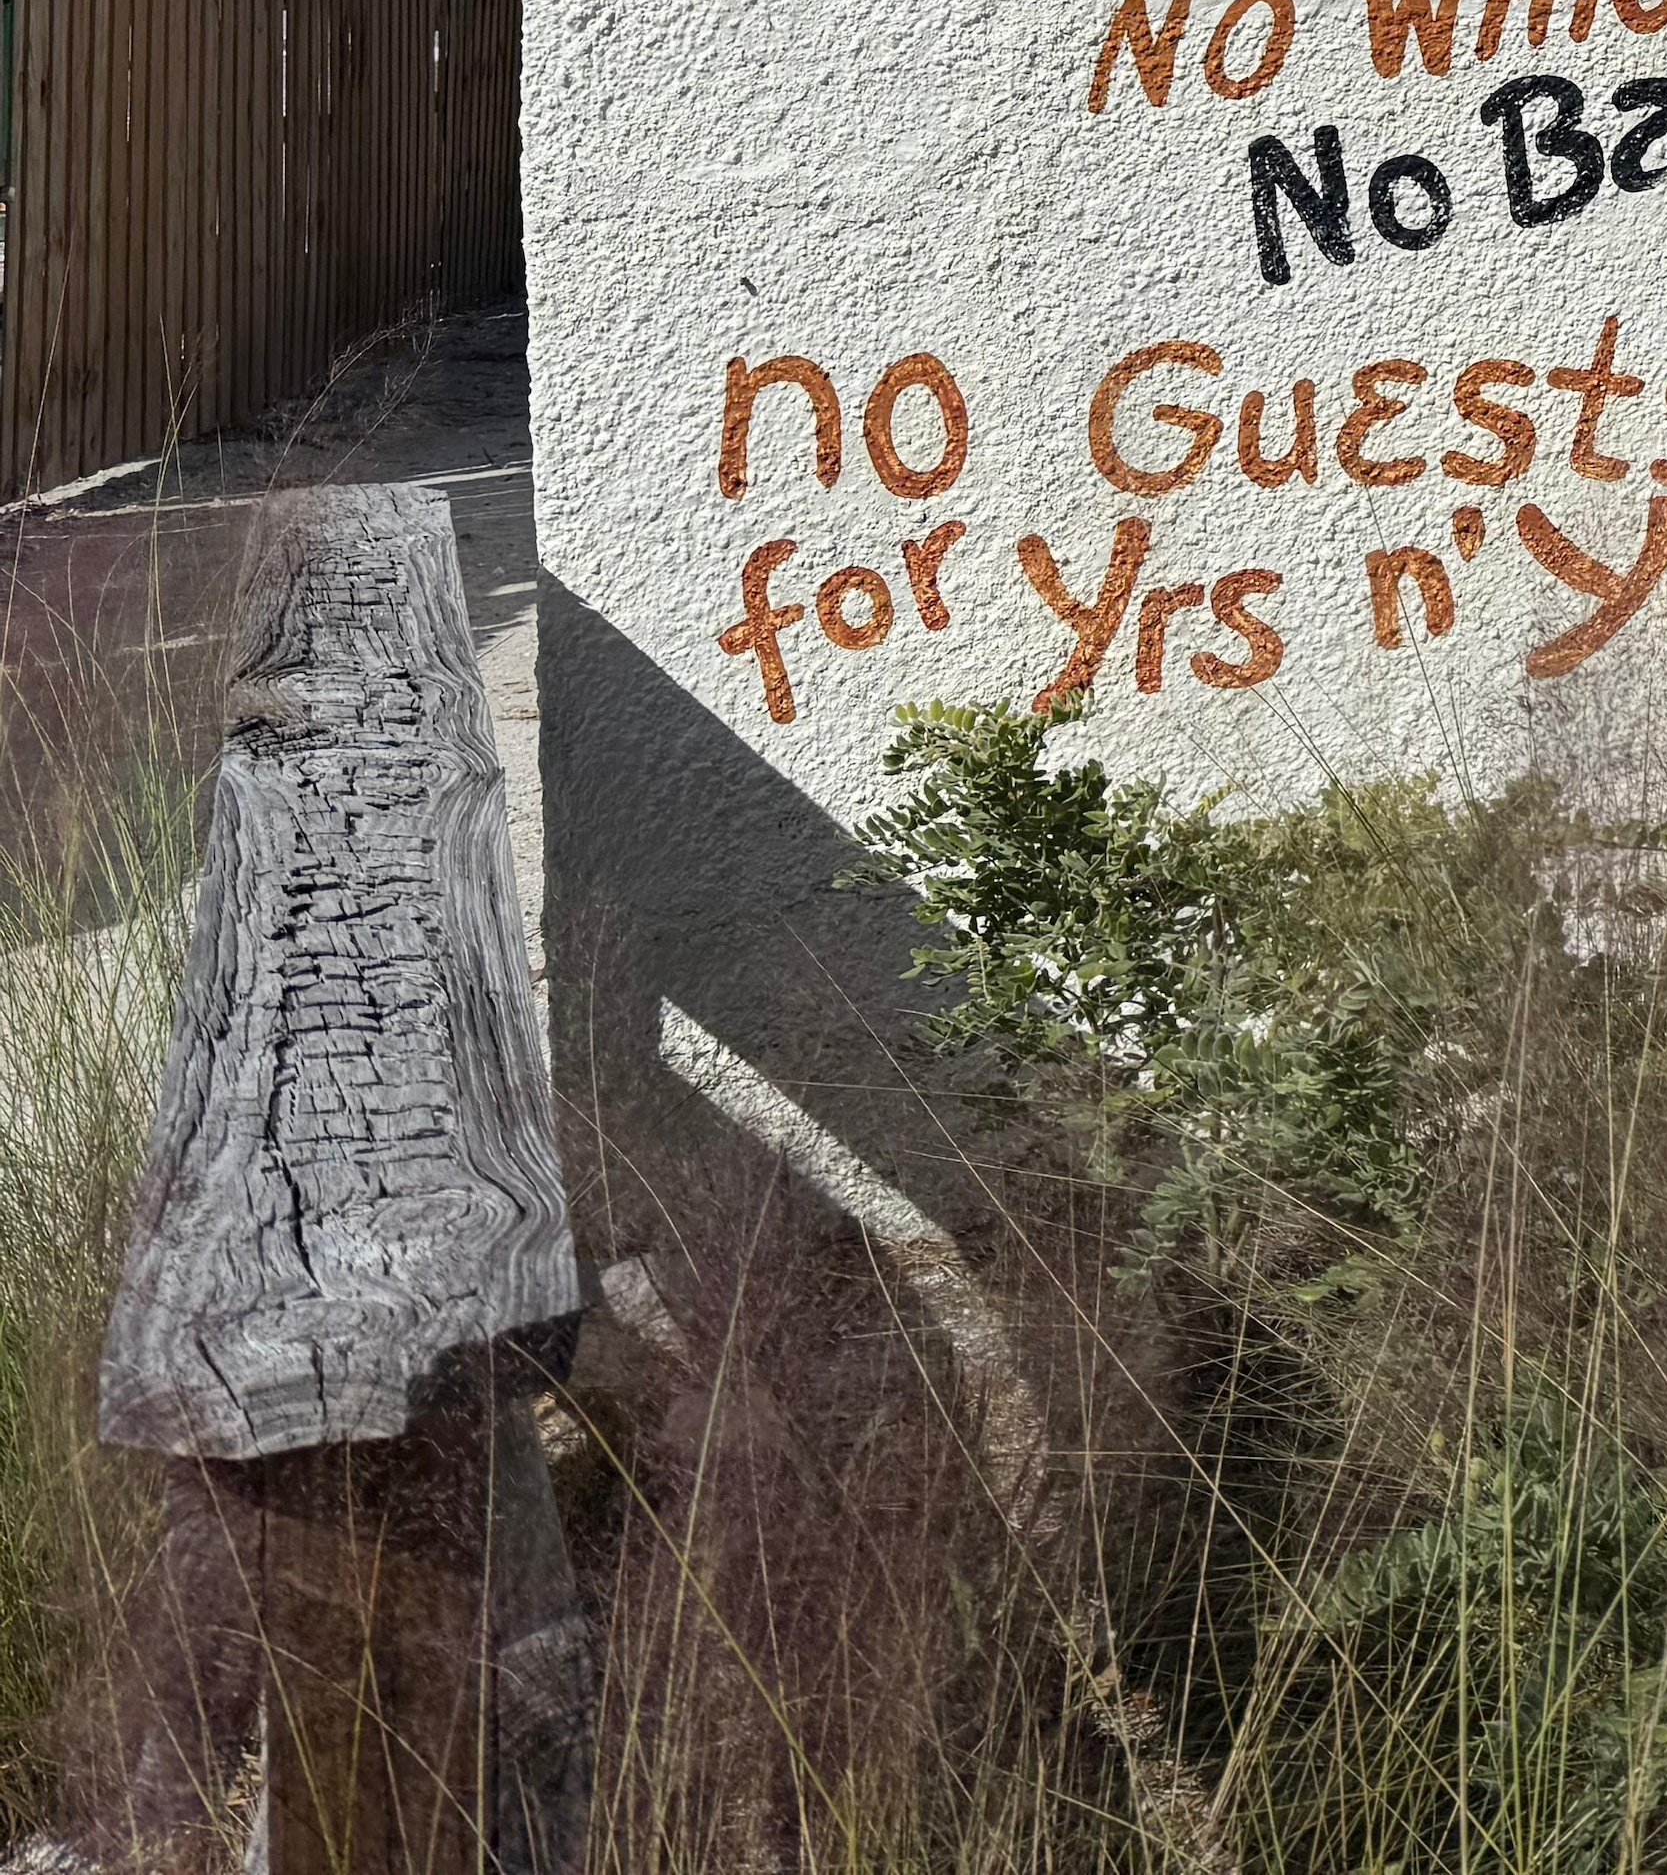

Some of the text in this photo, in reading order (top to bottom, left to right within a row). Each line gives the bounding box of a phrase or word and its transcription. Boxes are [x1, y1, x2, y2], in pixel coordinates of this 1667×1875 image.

[1247, 124, 1453, 286] No
[718, 353, 970, 500] no
[717, 519, 967, 725] for
